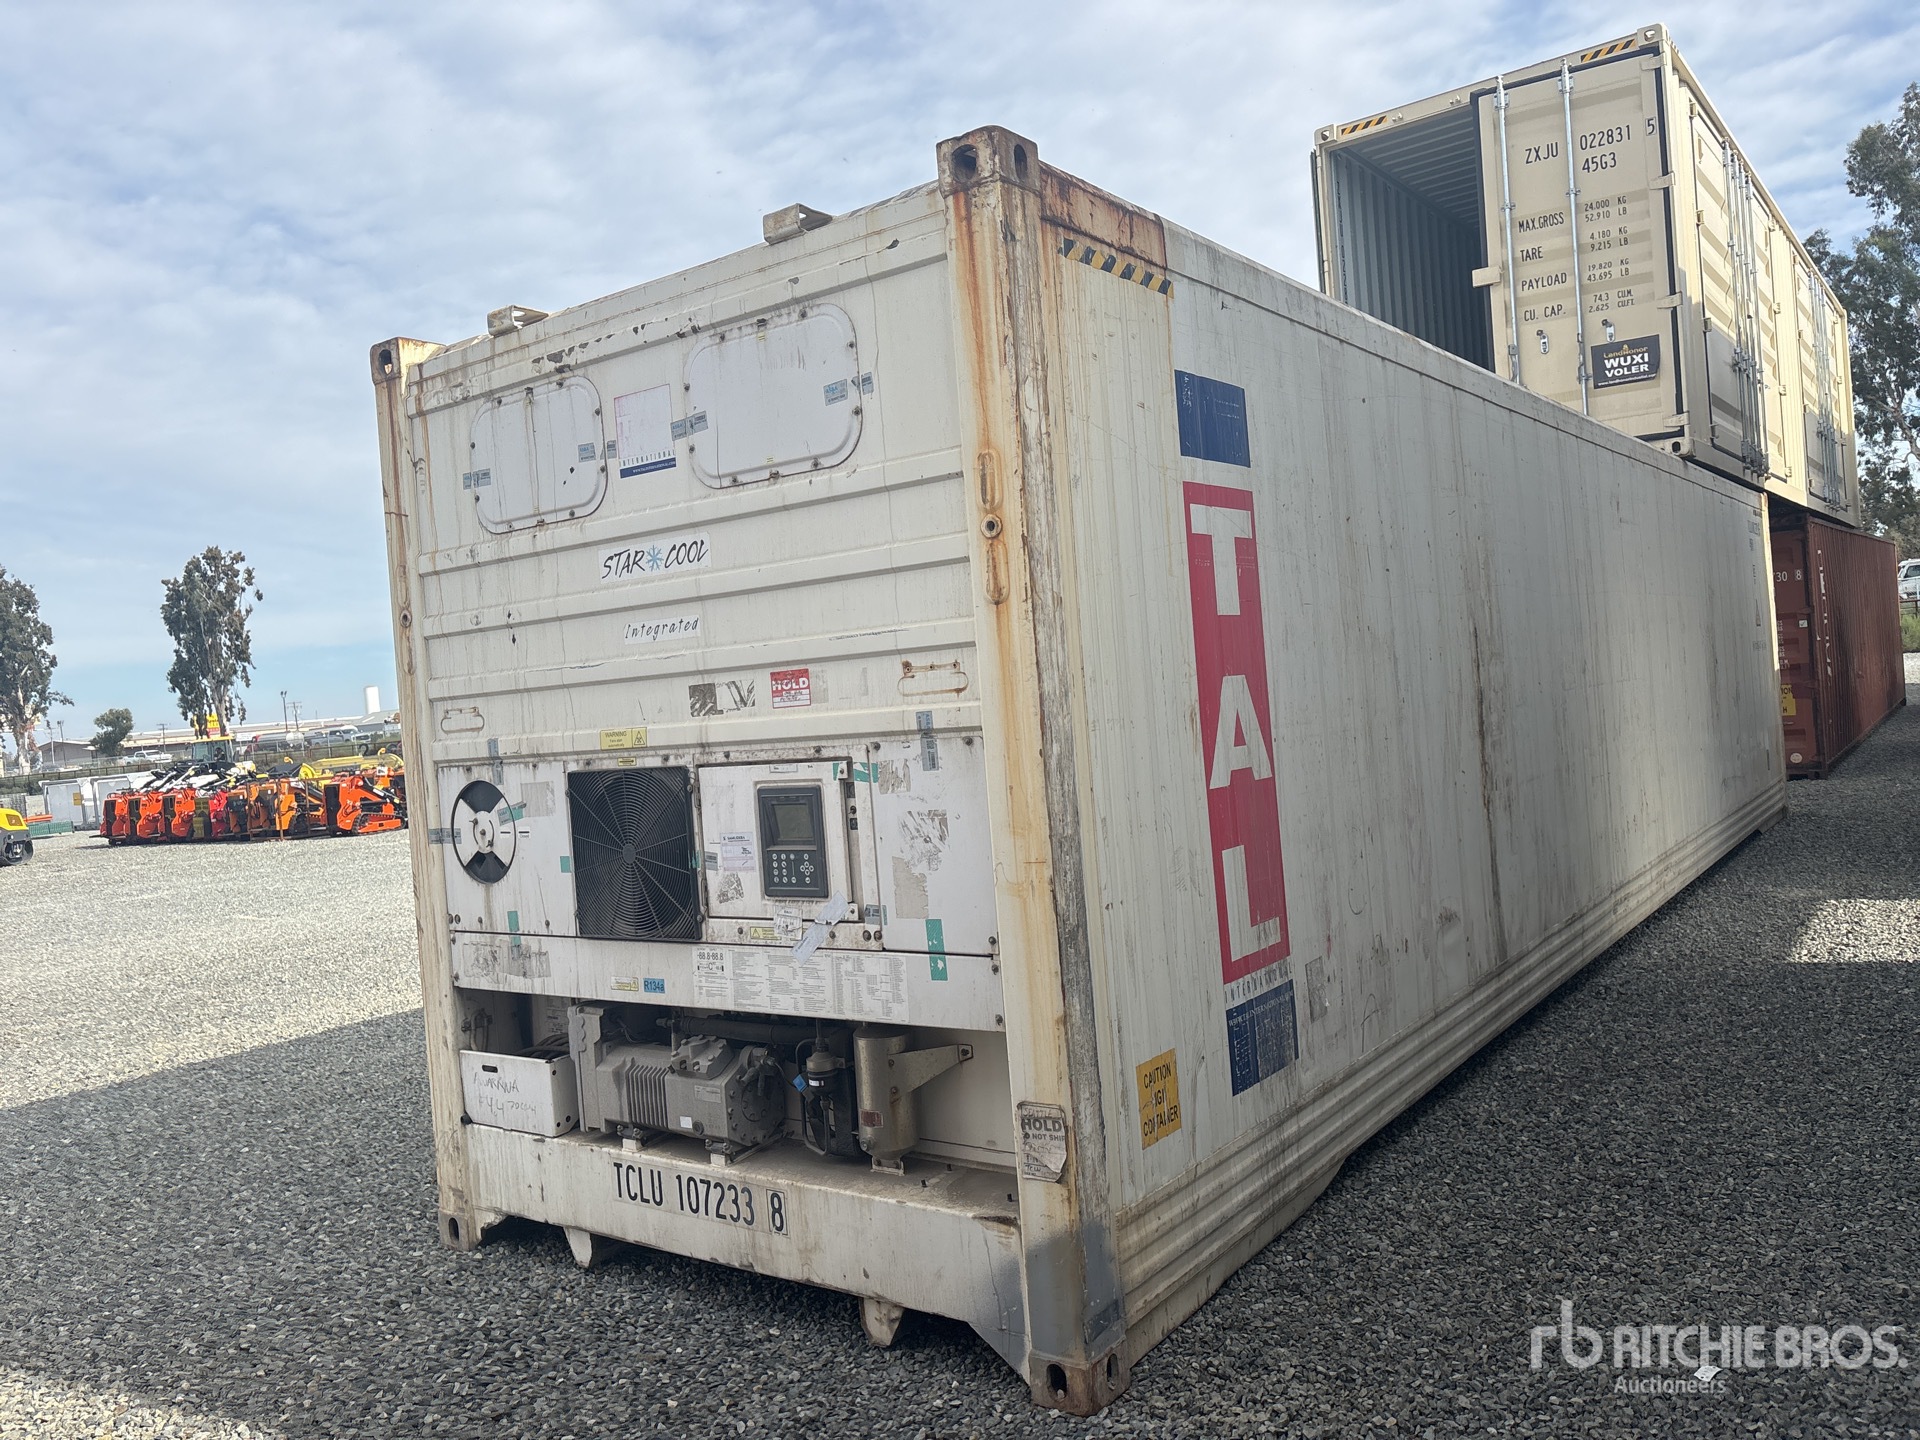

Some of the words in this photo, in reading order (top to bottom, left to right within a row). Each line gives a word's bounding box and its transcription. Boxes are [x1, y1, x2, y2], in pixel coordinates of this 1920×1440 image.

[1525, 142, 1559, 164] ZXJU
[1580, 125, 1631, 150] 022831
[1647, 118, 1655, 135] 5
[1582, 152, 1617, 173] 45G3
[1618, 196, 1627, 205] KG
[1618, 207, 1627, 216] LB
[1518, 212, 1564, 233] MAX.GROSS
[1618, 226, 1628, 235] KG
[1619, 237, 1628, 247] LB
[1520, 246, 1543, 262] TARE
[1620, 258, 1629, 266] KG
[1620, 268, 1629, 277] LB
[1521, 272, 1567, 291] PAYLOAD
[1524, 310, 1539, 322] CU.
[1544, 304, 1566, 318] CAP.
[1604, 353, 1649, 368] WUXI
[1605, 364, 1649, 377] VOLER
[601, 548, 646, 580] STAR
[664, 538, 709, 569] COOL
[1795, 570, 1802, 580] 8
[625, 617, 700, 641] Integrated
[772, 677, 809, 691] HOLD
[643, 980, 665, 992] R134a
[1143, 1062, 1171, 1089] CAUTION
[1021, 1118, 1063, 1132] HOLD
[613, 1162, 663, 1207] TCLU
[676, 1174, 755, 1226] 107233
[770, 1192, 785, 1232] 8
